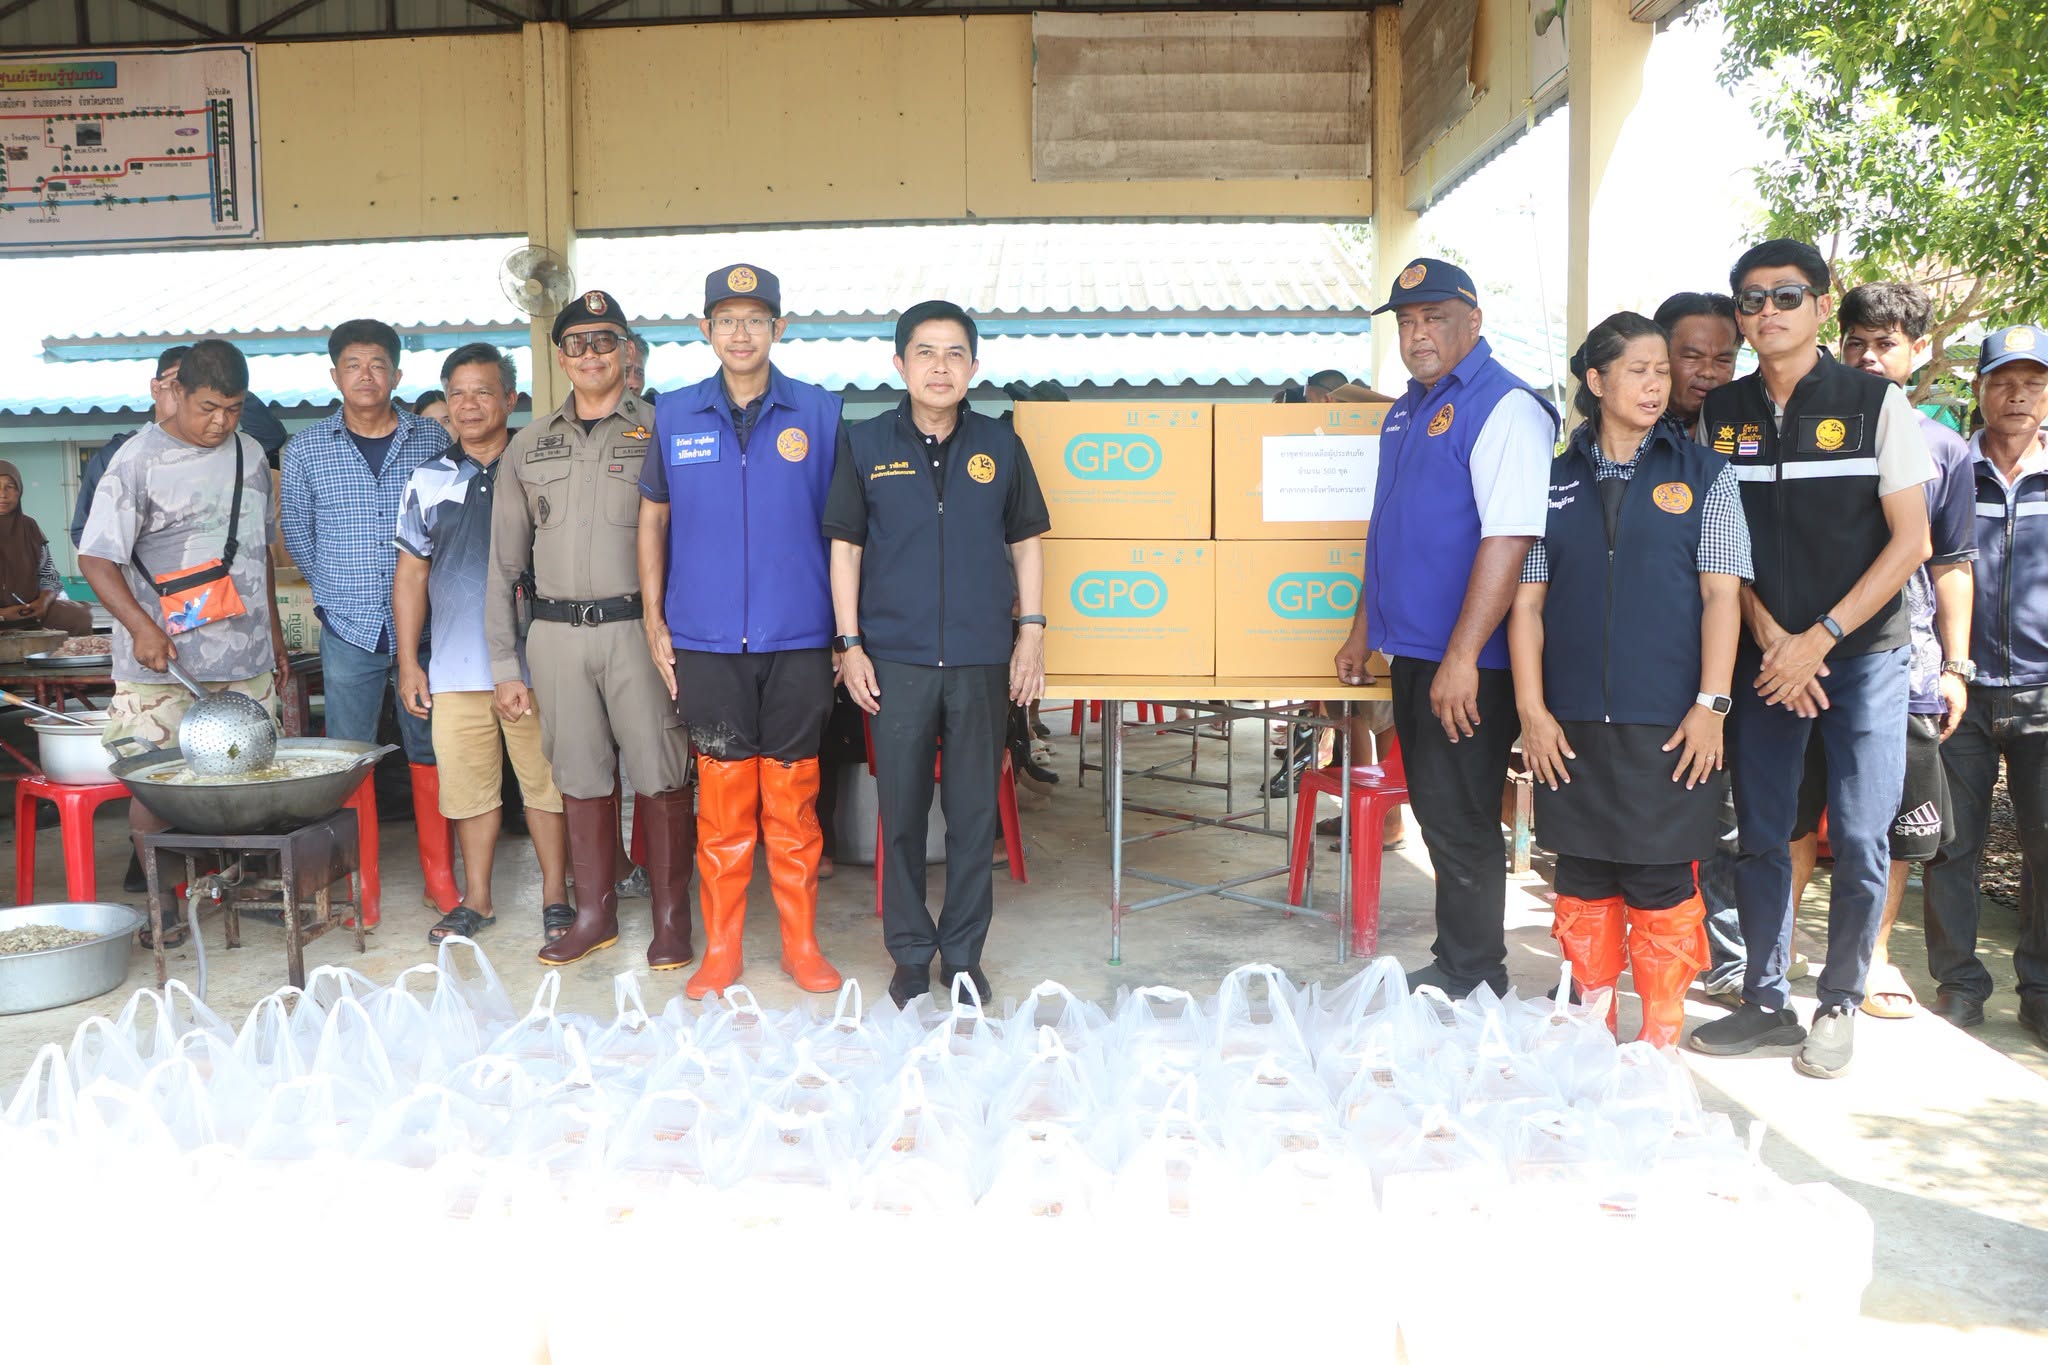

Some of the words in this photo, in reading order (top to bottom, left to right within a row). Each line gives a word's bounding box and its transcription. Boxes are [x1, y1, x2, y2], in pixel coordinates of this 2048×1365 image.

[1072, 441, 1155, 473] GPO
[1078, 579, 1161, 610] GPO
[1276, 580, 1358, 611] GPO
[1895, 821, 1943, 836] SPORT
